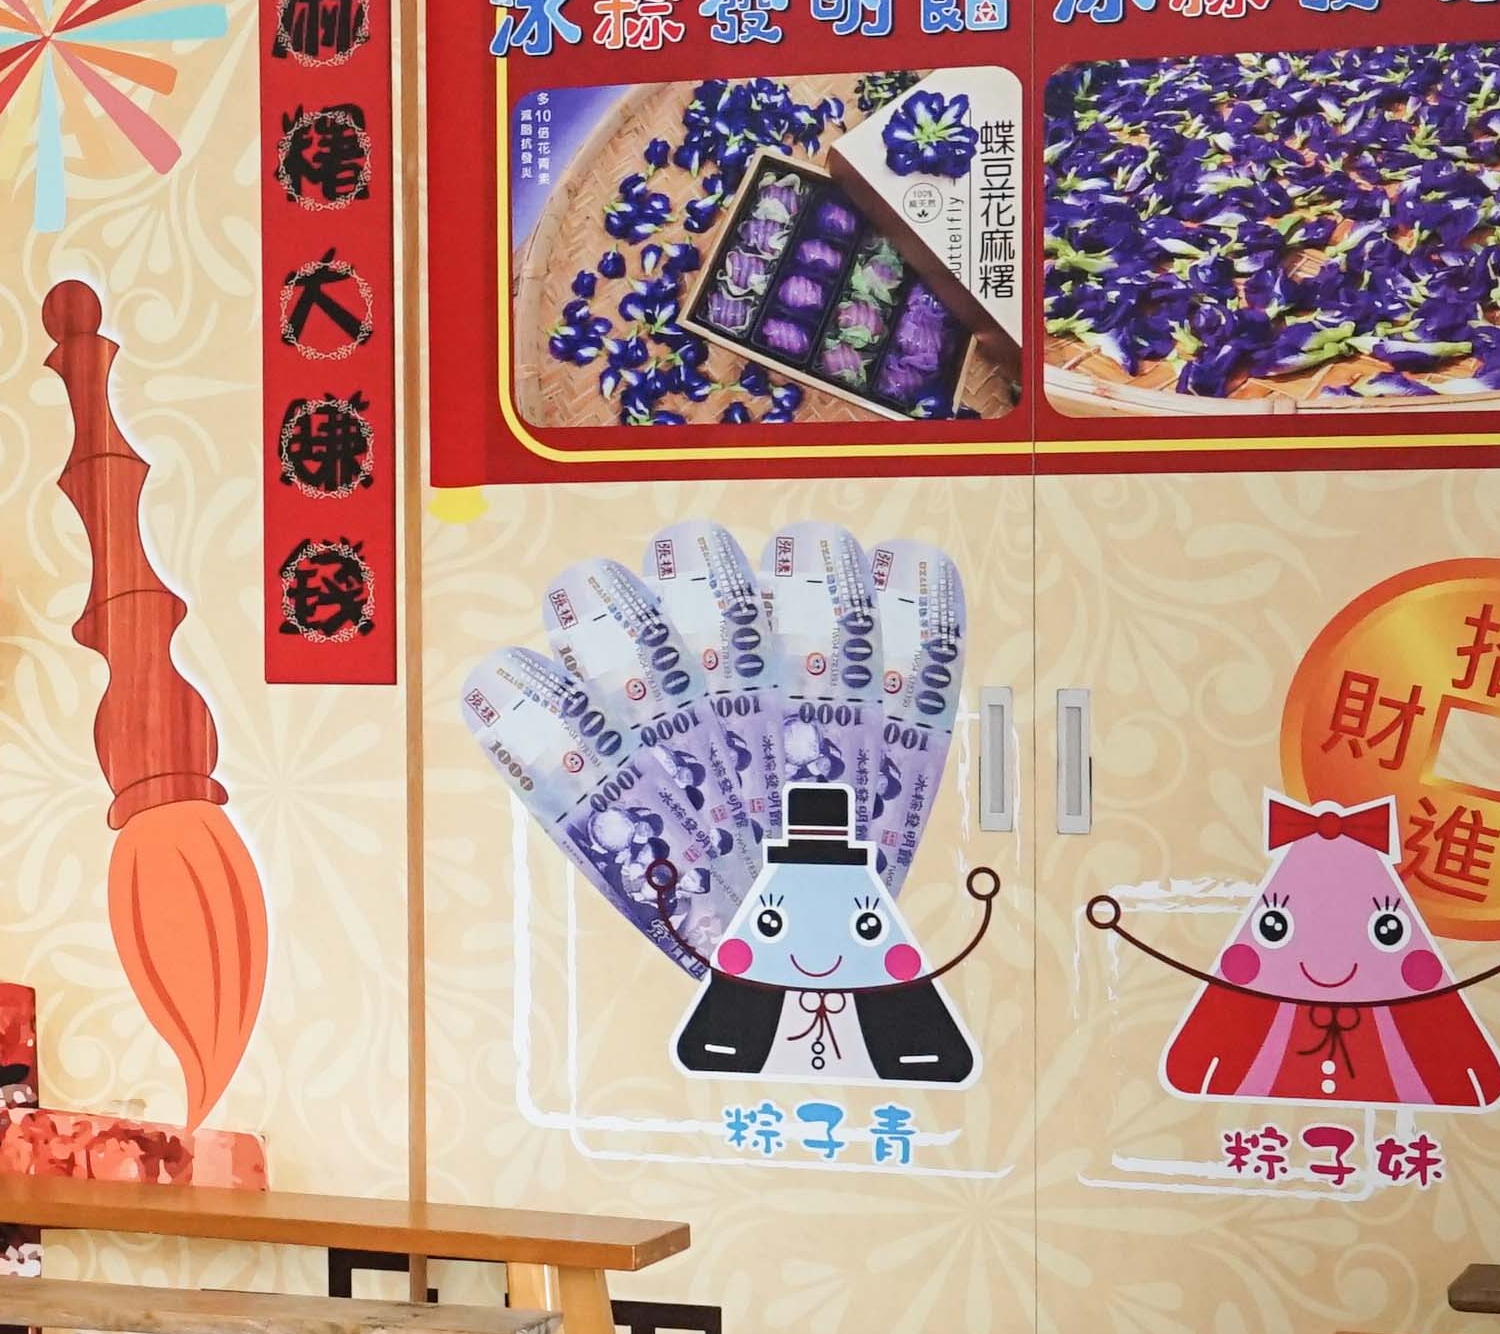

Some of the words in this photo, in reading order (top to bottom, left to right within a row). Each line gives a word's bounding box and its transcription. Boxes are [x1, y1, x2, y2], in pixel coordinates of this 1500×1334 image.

[978, 120, 1016, 300] 蝶豆花麻糬
[641, 710, 702, 748] 1000
[799, 702, 865, 727] 1000
[488, 740, 535, 792] 1000
[590, 766, 643, 813] 1000
[761, 734, 782, 828] 冰粽發明館
[897, 774, 929, 867] 冰粽發明館
[723, 1102, 918, 1167] 粽子青
[1222, 1124, 1444, 1188] 粽子妹
